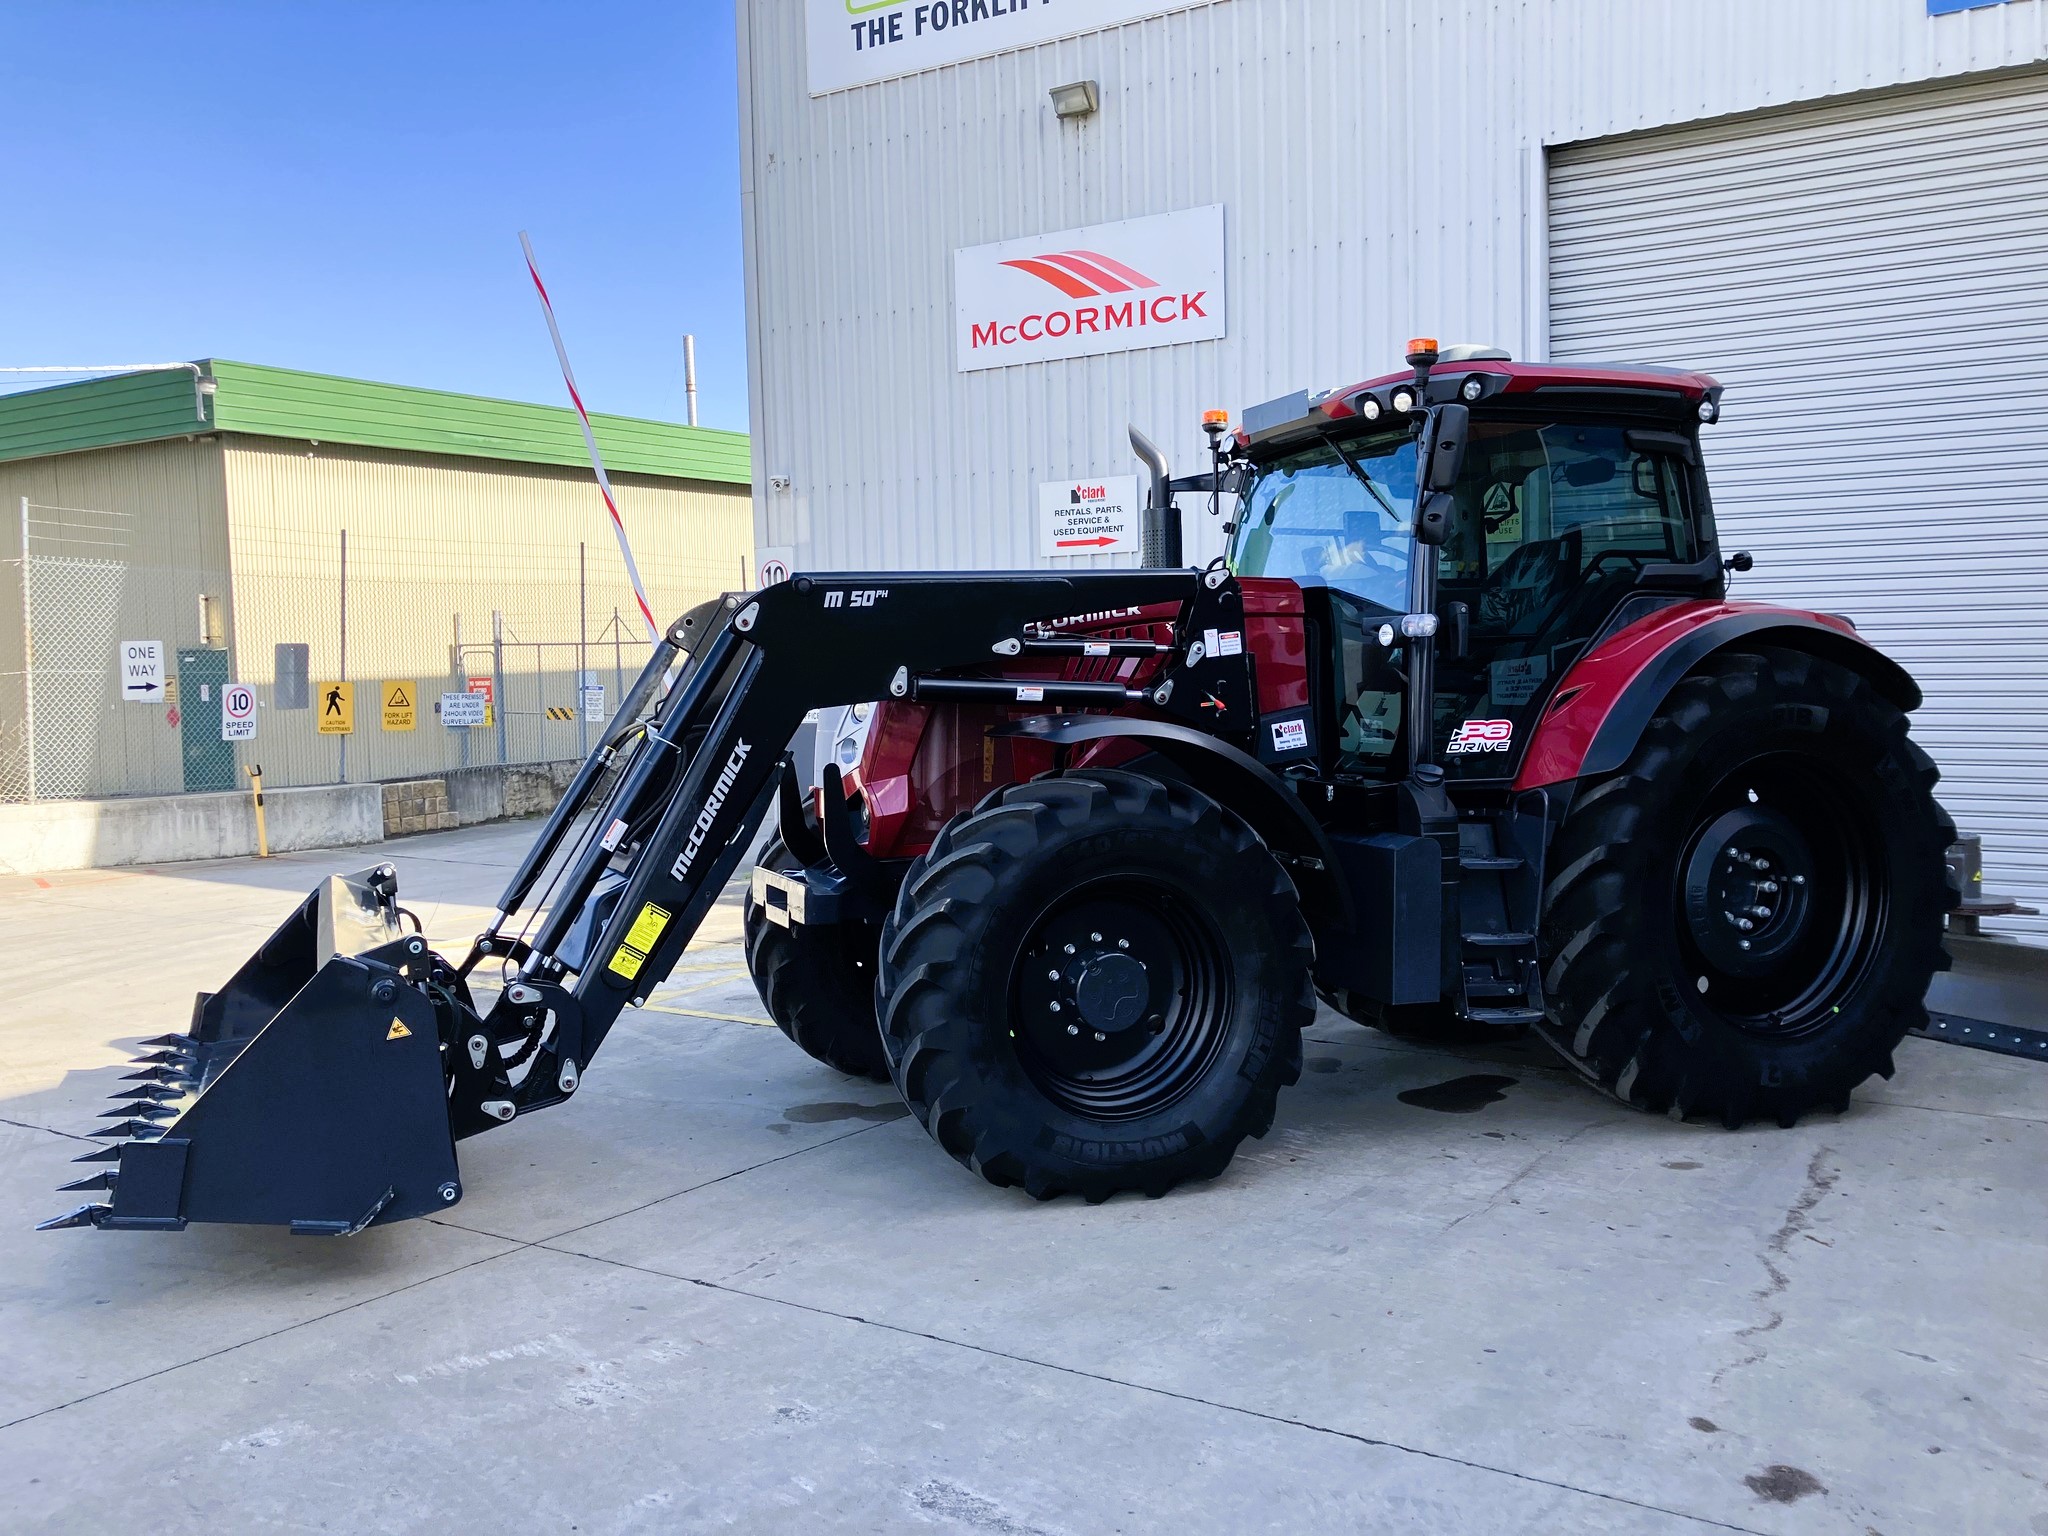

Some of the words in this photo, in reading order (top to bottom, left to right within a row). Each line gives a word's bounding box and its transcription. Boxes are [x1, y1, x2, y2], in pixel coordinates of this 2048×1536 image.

[851, 12, 903, 50] THE
[915, 0, 1050, 36] FORKL
[971, 290, 1208, 349] McCORMICK
[1082, 485, 1106, 500] clark
[1067, 516, 1102, 526] SERVICE
[1104, 516, 1110, 524] &
[1053, 528, 1076, 537] USED
[1077, 525, 1124, 535] EQUIPMENT
[765, 565, 785, 588] 10
[128, 646, 155, 659] ONE
[128, 664, 156, 677] WAY
[231, 693, 249, 711] 10
[443, 693, 461, 701] THESE
[226, 721, 254, 729] SPEED
[1283, 723, 1303, 734] clark
[228, 729, 250, 737] LIMIT
[1446, 740, 1511, 753] DRIVE
